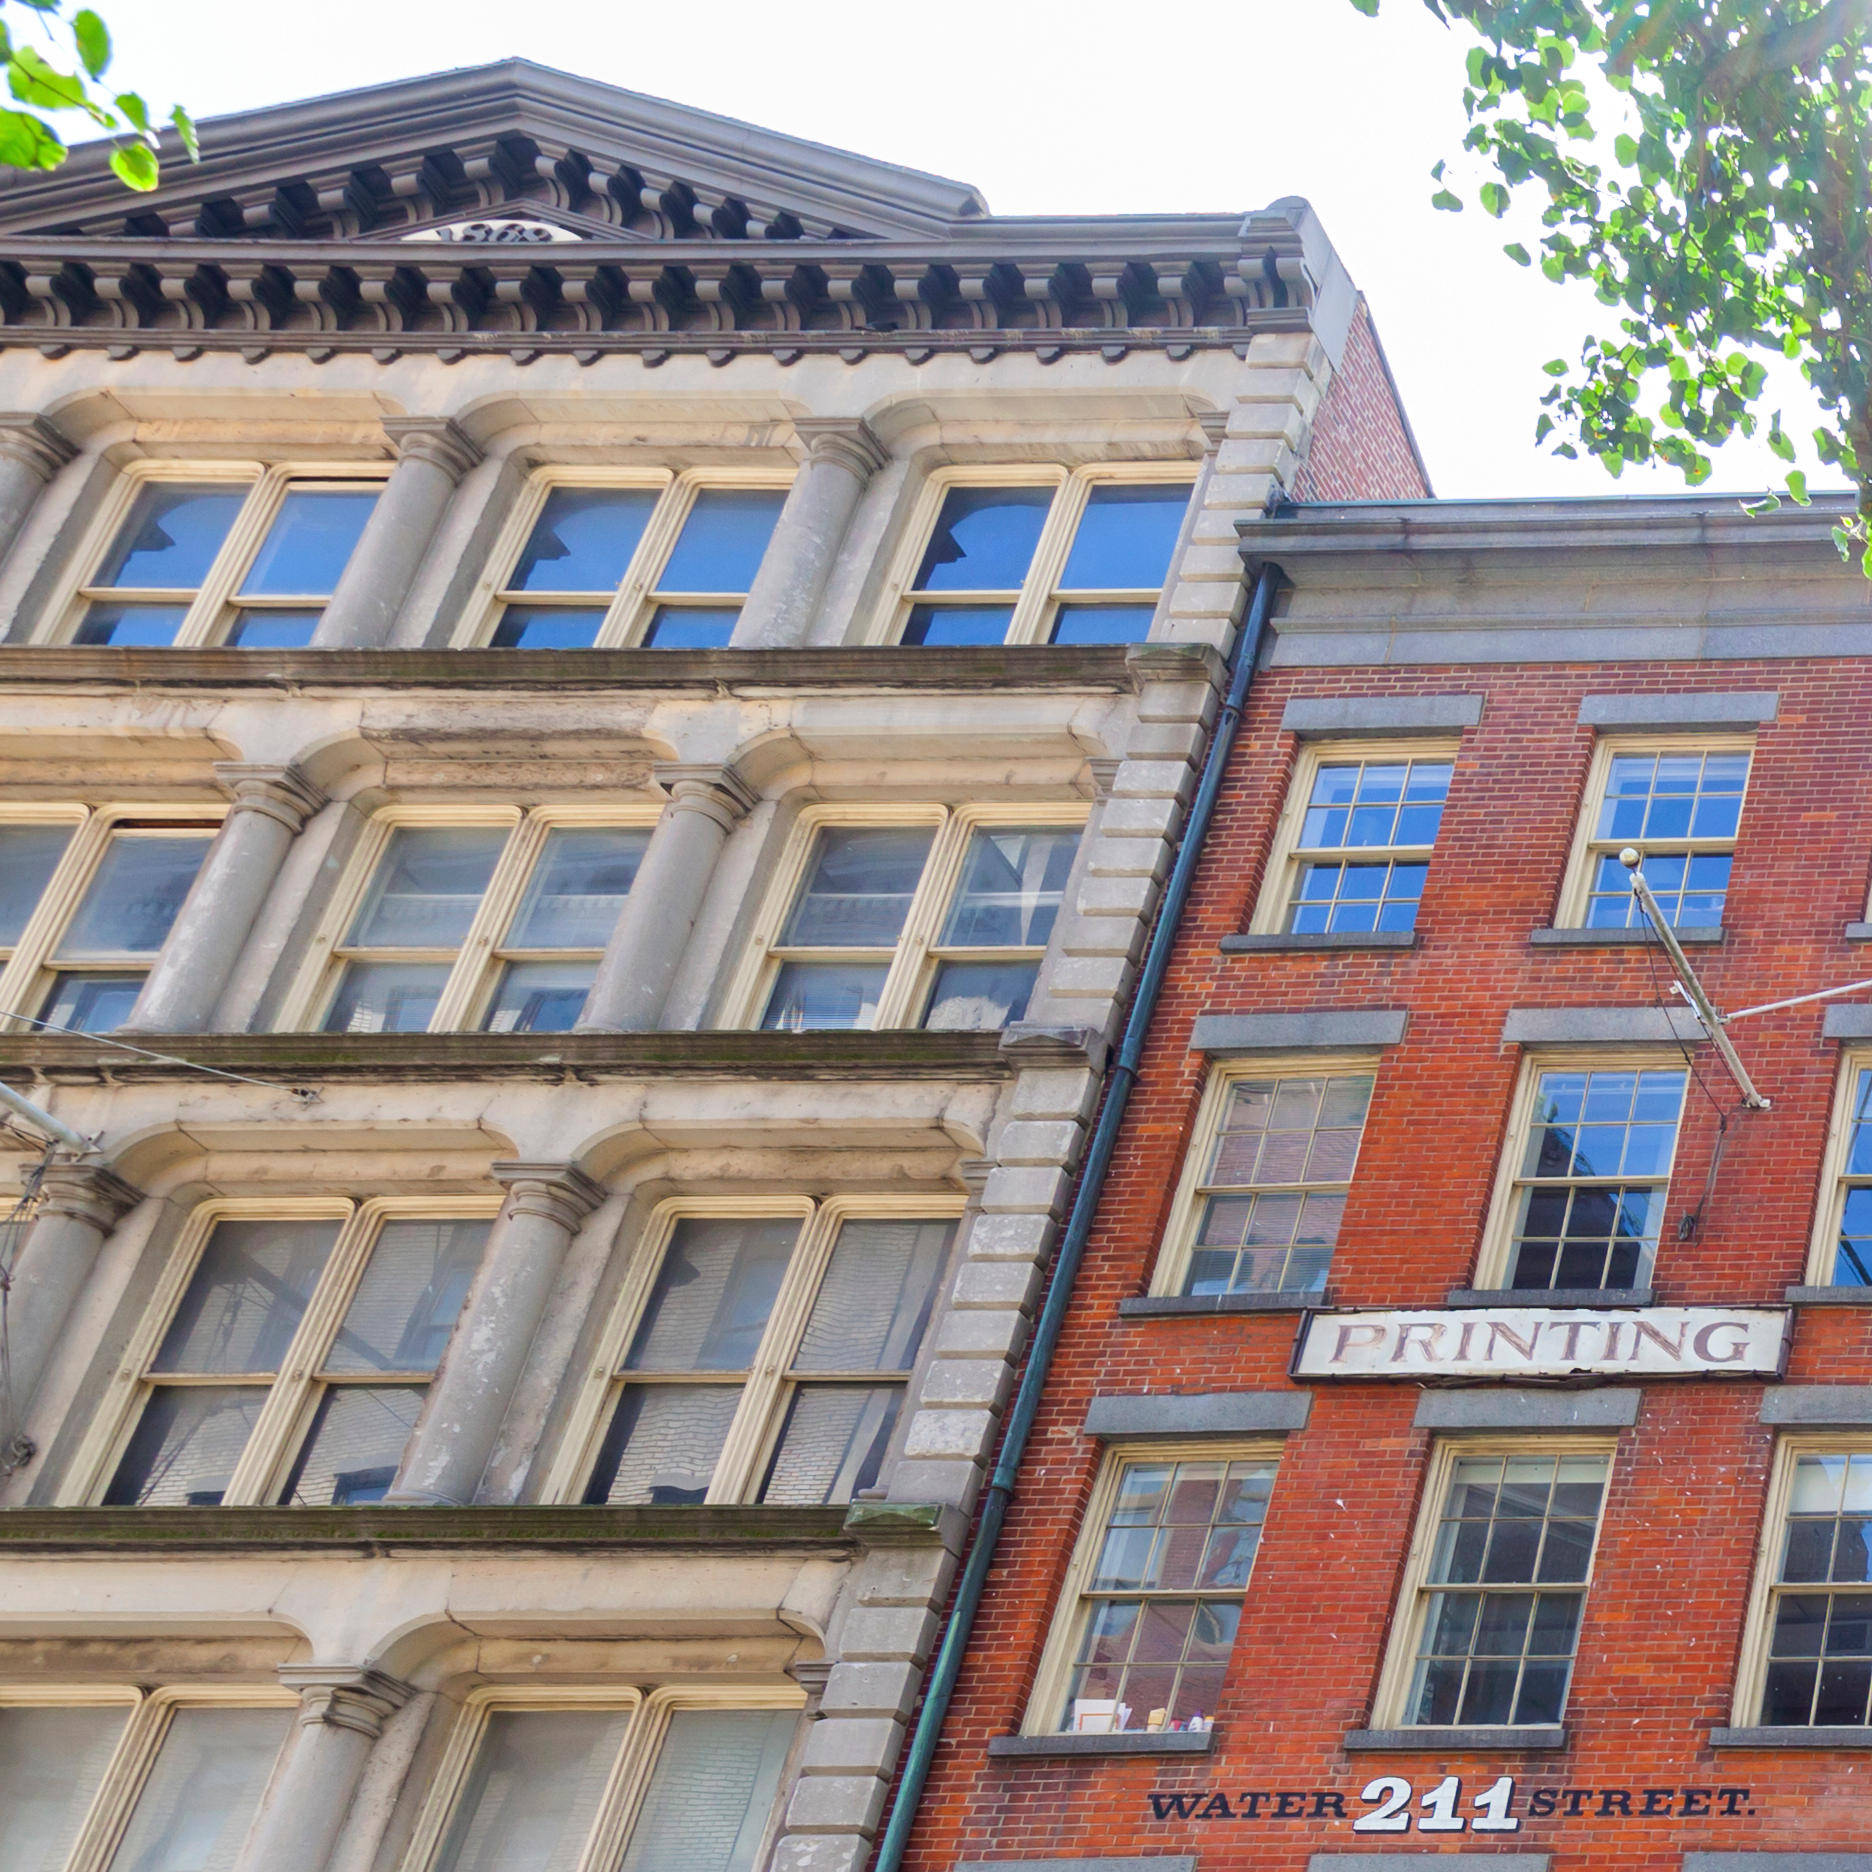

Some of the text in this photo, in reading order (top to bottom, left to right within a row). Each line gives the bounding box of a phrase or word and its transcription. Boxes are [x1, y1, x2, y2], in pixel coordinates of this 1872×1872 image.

[1329, 1321, 1751, 1364] PRINTING
[1147, 1775, 1756, 1833] WATER 211 STREET.
